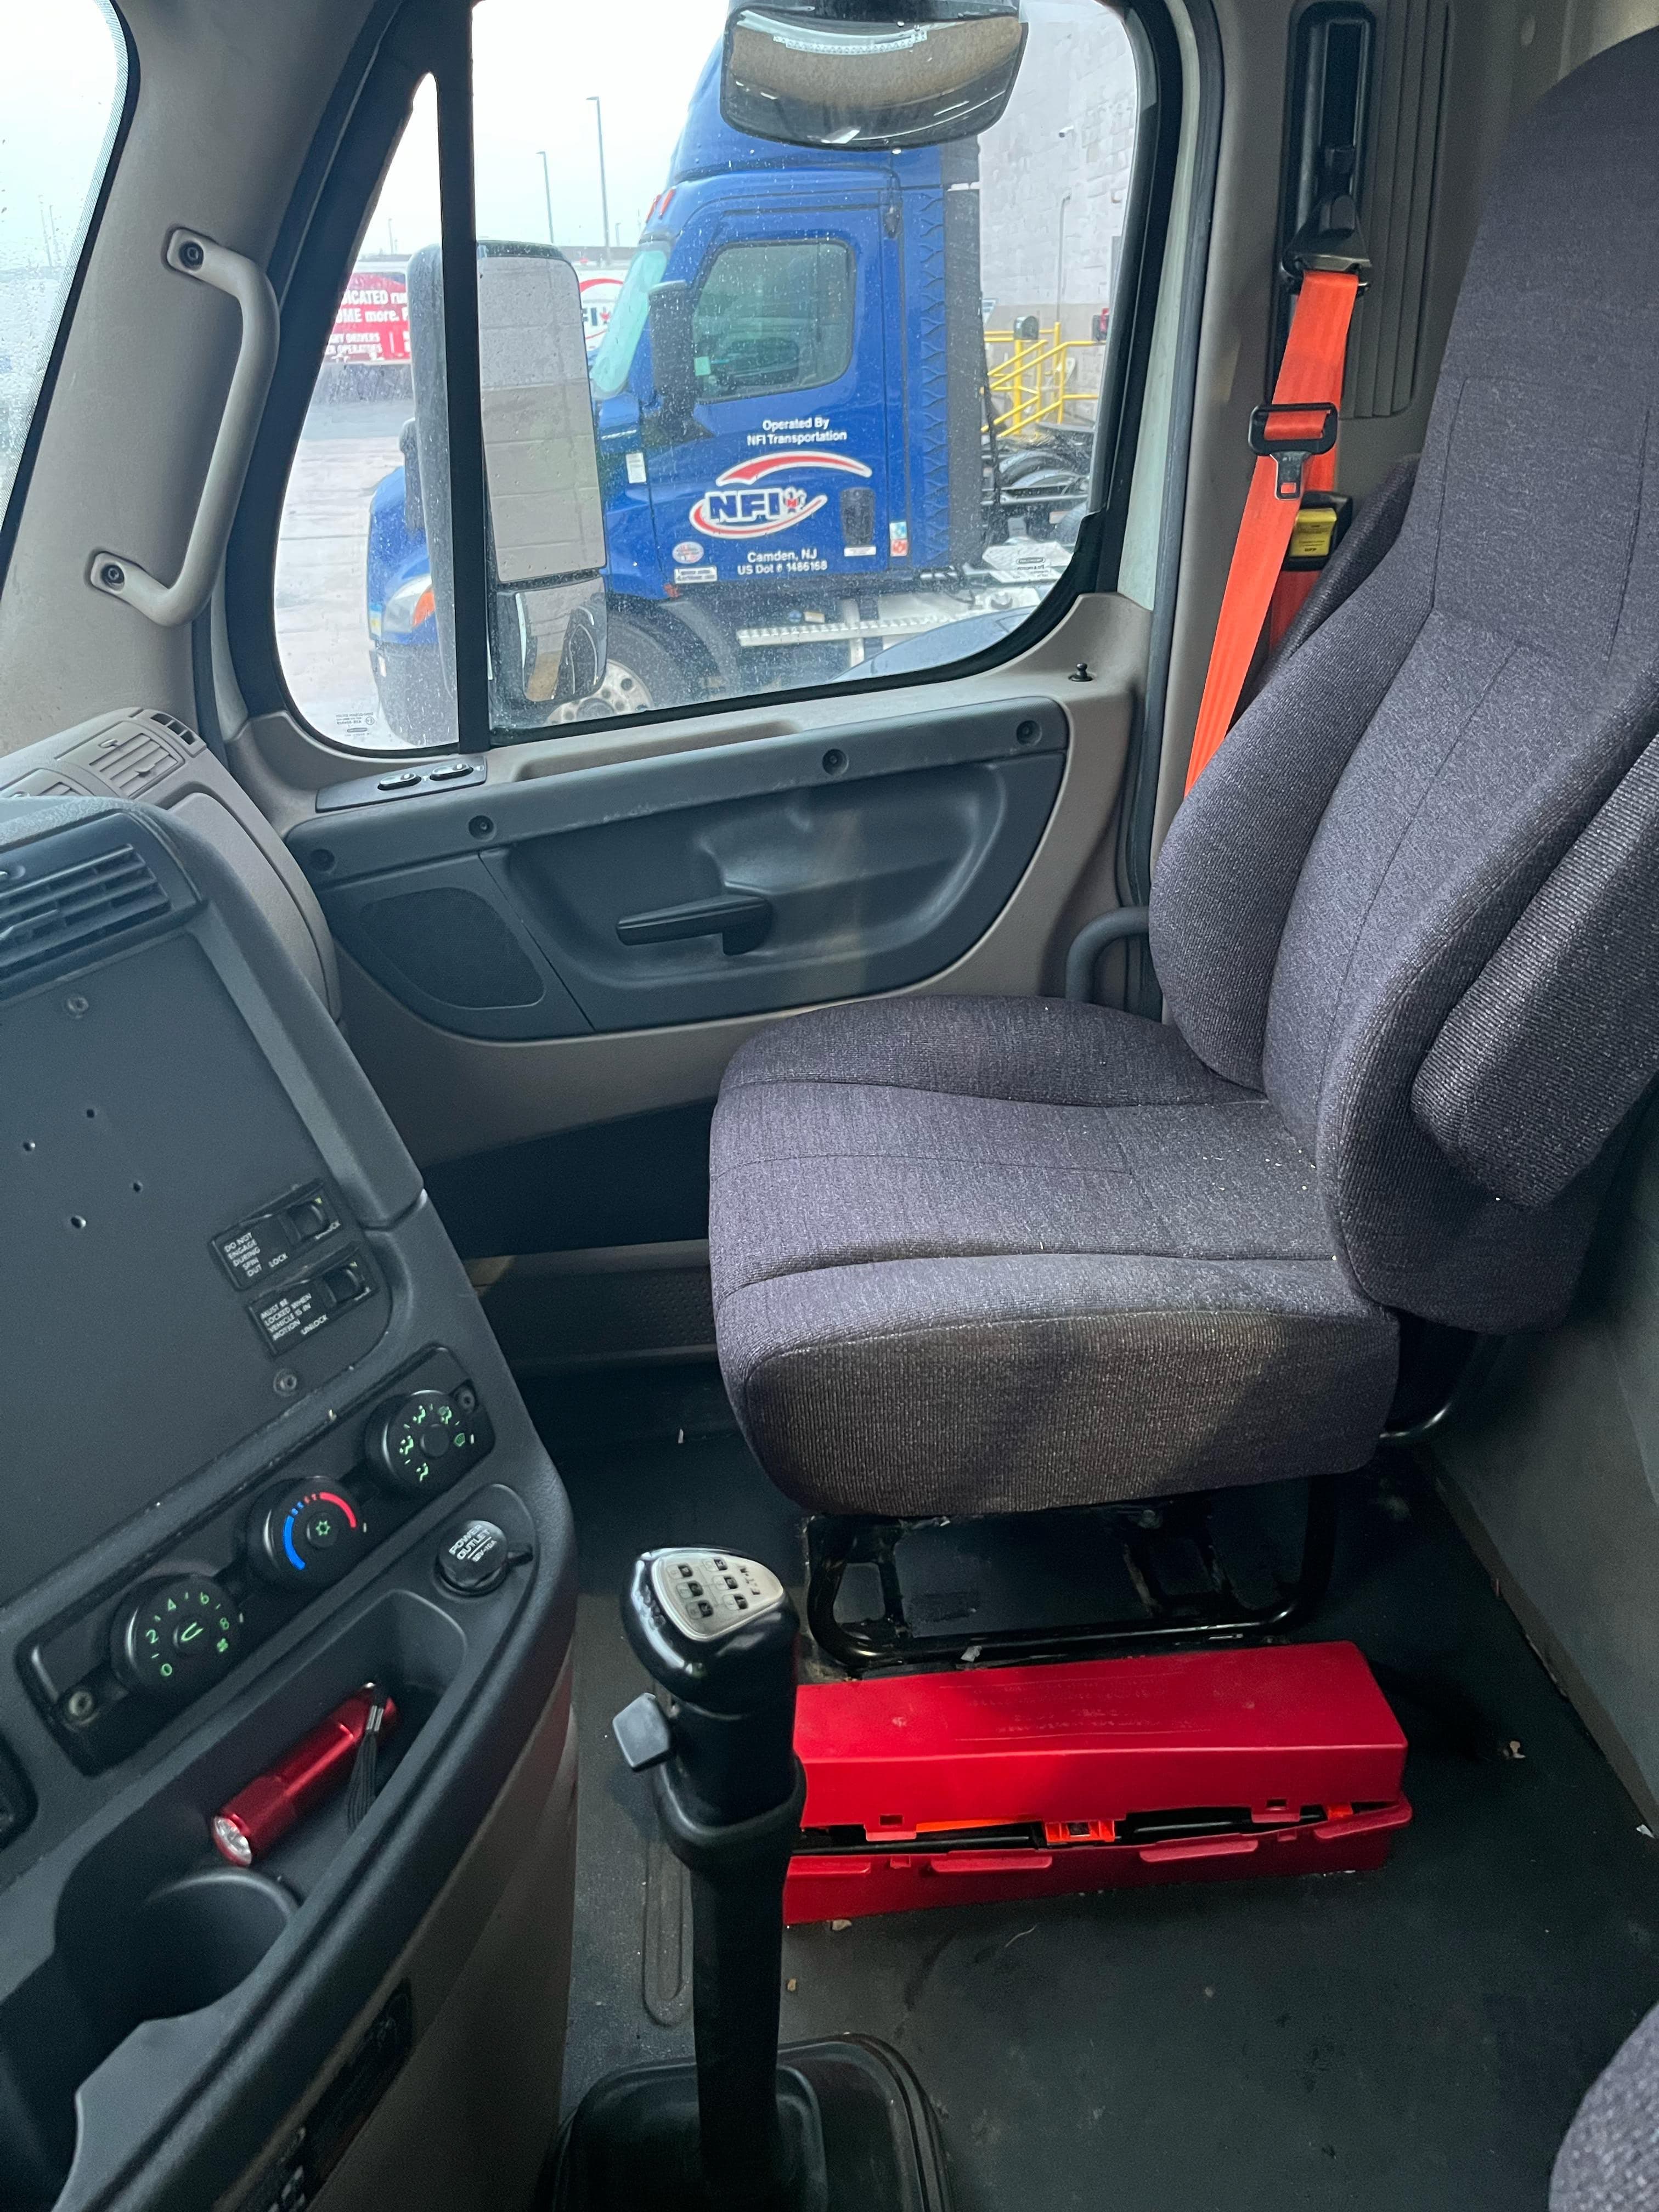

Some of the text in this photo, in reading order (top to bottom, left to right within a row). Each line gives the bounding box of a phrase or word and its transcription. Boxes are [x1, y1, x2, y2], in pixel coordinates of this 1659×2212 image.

[342, 290, 388, 304] ICATED
[336, 308, 362, 323] OME
[762, 417, 830, 432] Operated By
[747, 430, 848, 446] NFI Transportation
[707, 490, 782, 521] NFI
[747, 548, 817, 563] Camden, NJ
[737, 565, 753, 575] US
[224, 1232, 252, 1252] DO NOT
[233, 1246, 261, 1267] DURING
[268, 1252, 288, 1268] LOCK
[246, 1263, 262, 1277] OUT
[261, 1304, 279, 1319] MUST
[264, 1293, 312, 1326] LOCKED WHEN
[269, 1313, 295, 1333] VEHICLE
[302, 1303, 311, 1312] IN
[301, 1314, 328, 1335] UNLOCK
[273, 1318, 301, 1340] MOTION
[449, 1525, 483, 1555] POWER
[456, 1530, 490, 1560] OUTLET
[168, 1598, 176, 1611] 4
[200, 1592, 210, 1605] 6
[219, 1617, 229, 1630] 8
[145, 1629, 159, 1644] 2
[161, 1663, 172, 1677] 0
